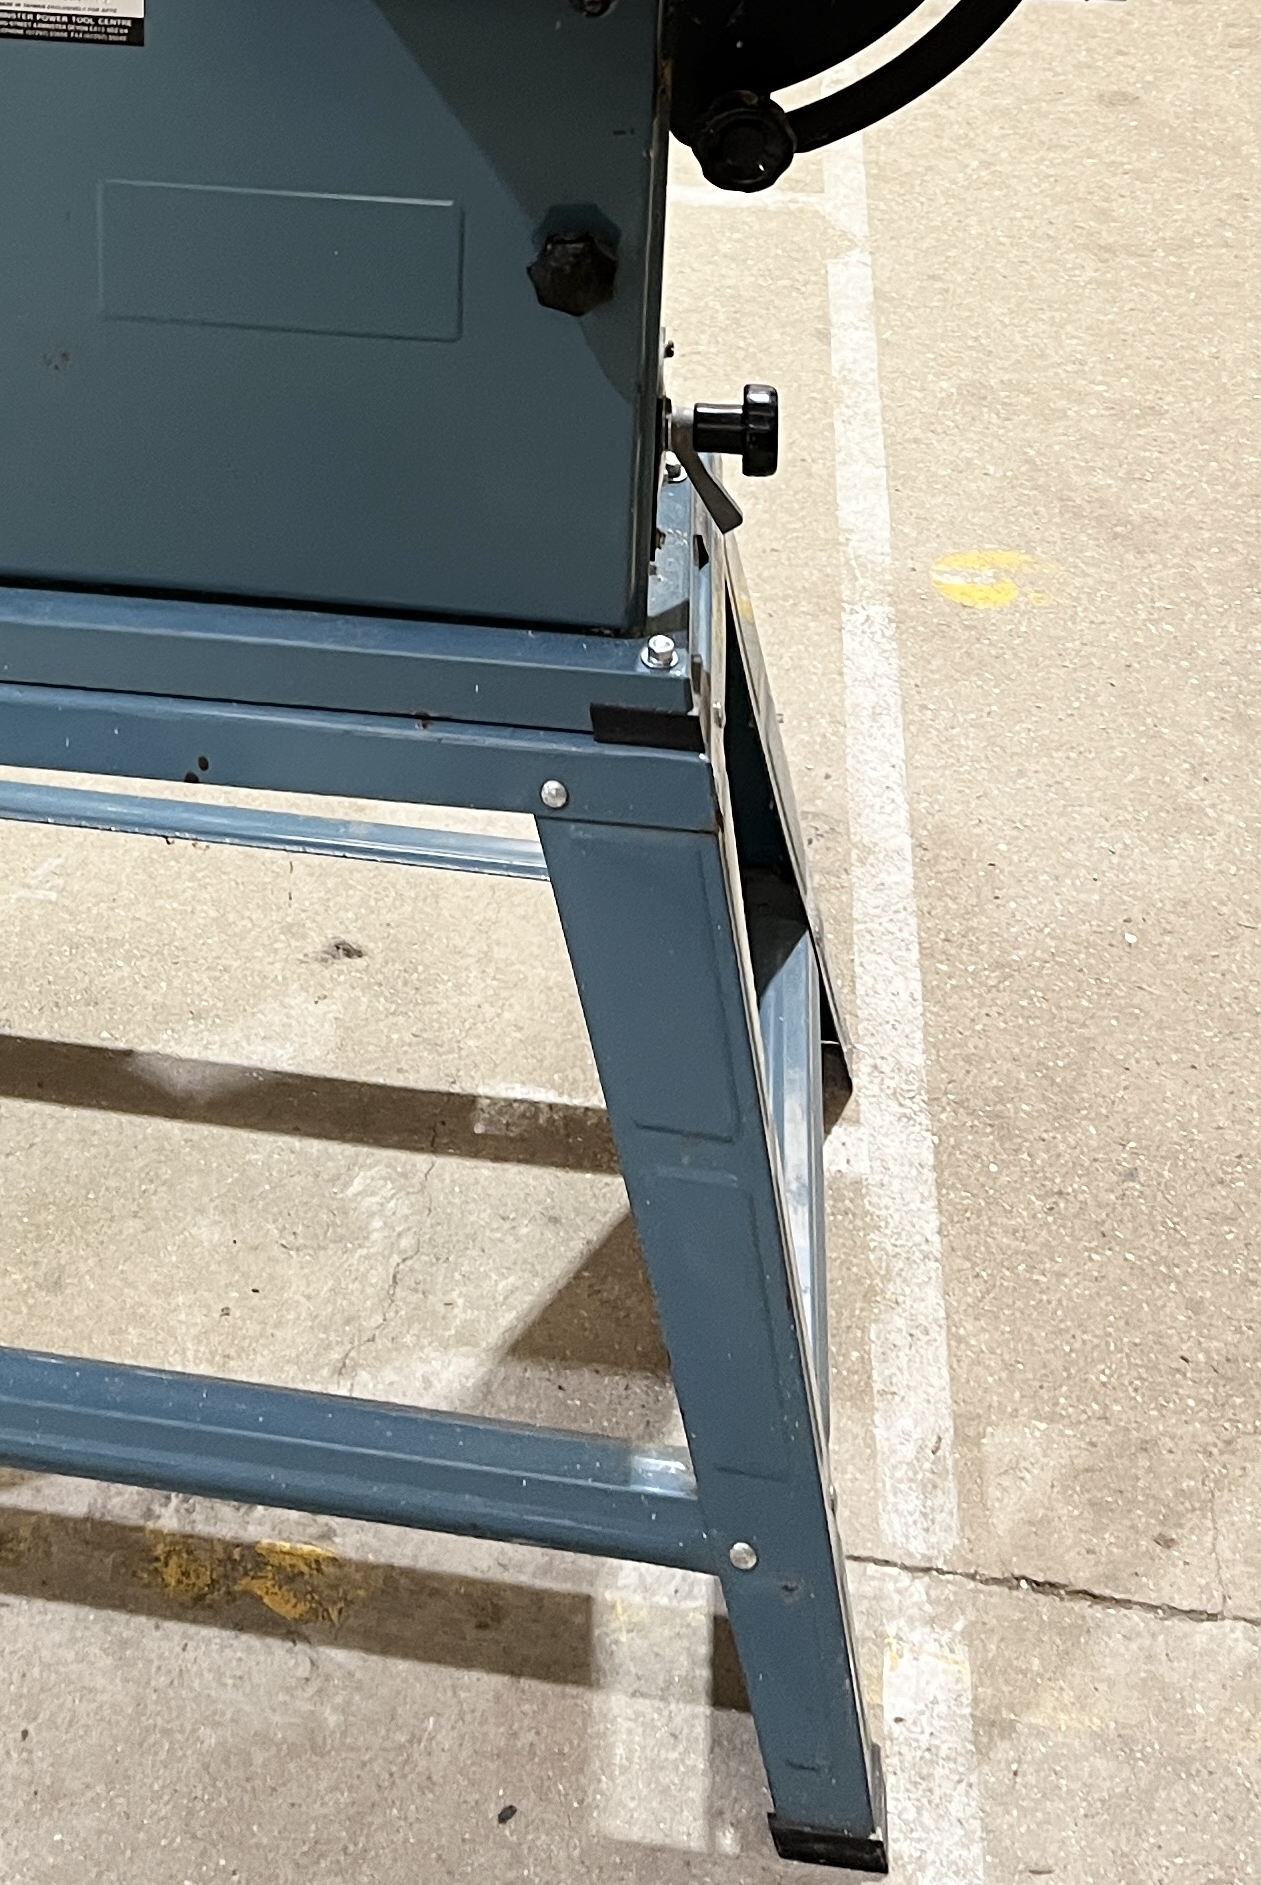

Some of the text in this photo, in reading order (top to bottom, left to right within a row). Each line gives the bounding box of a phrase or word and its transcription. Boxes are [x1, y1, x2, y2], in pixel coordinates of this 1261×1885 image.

[36, 14, 69, 23] POWER
[72, 16, 96, 25] TOOL
[97, 17, 132, 27] CENTRE
